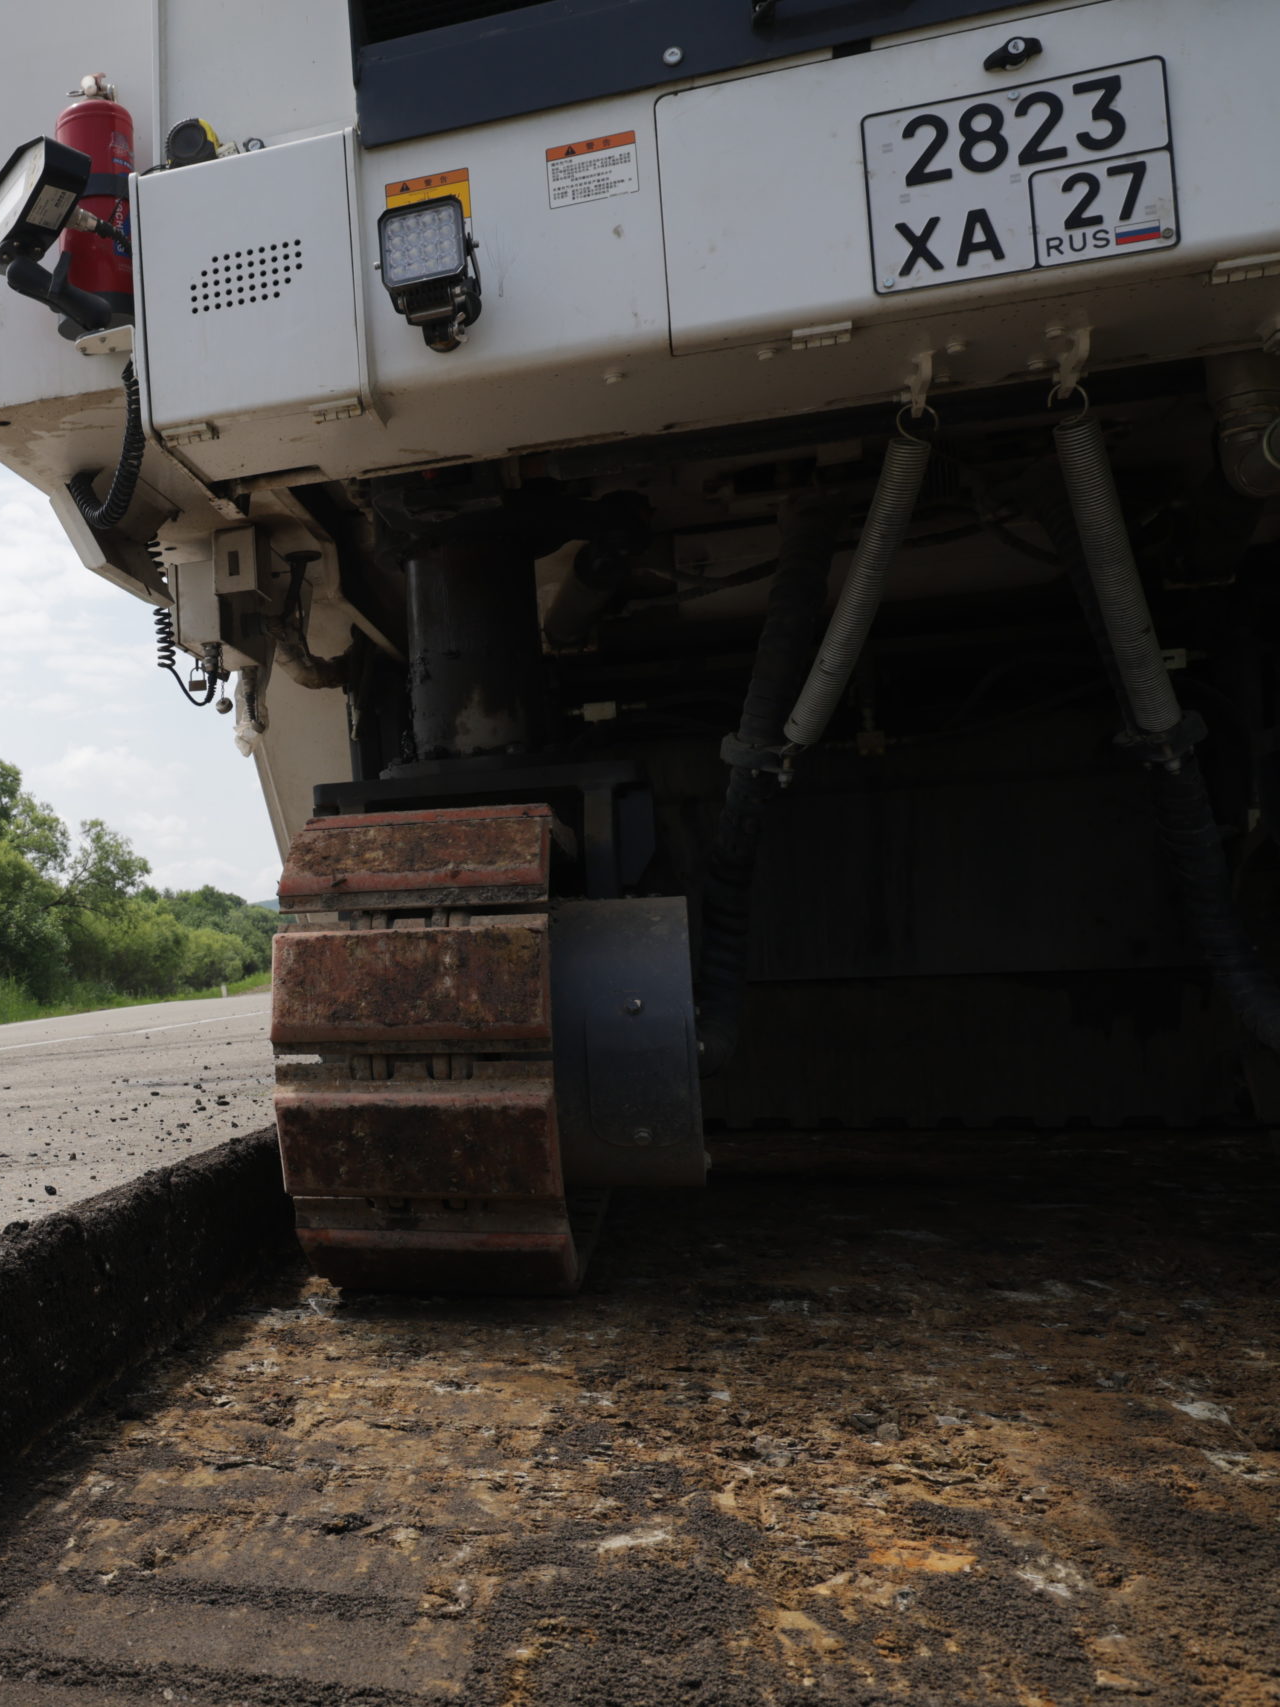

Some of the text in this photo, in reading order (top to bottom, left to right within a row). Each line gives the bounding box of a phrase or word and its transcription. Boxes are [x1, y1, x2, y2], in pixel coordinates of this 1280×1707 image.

[902, 74, 1127, 187] 2823
[1061, 160, 1147, 230] 27
[1046, 229, 1111, 257] RUS
